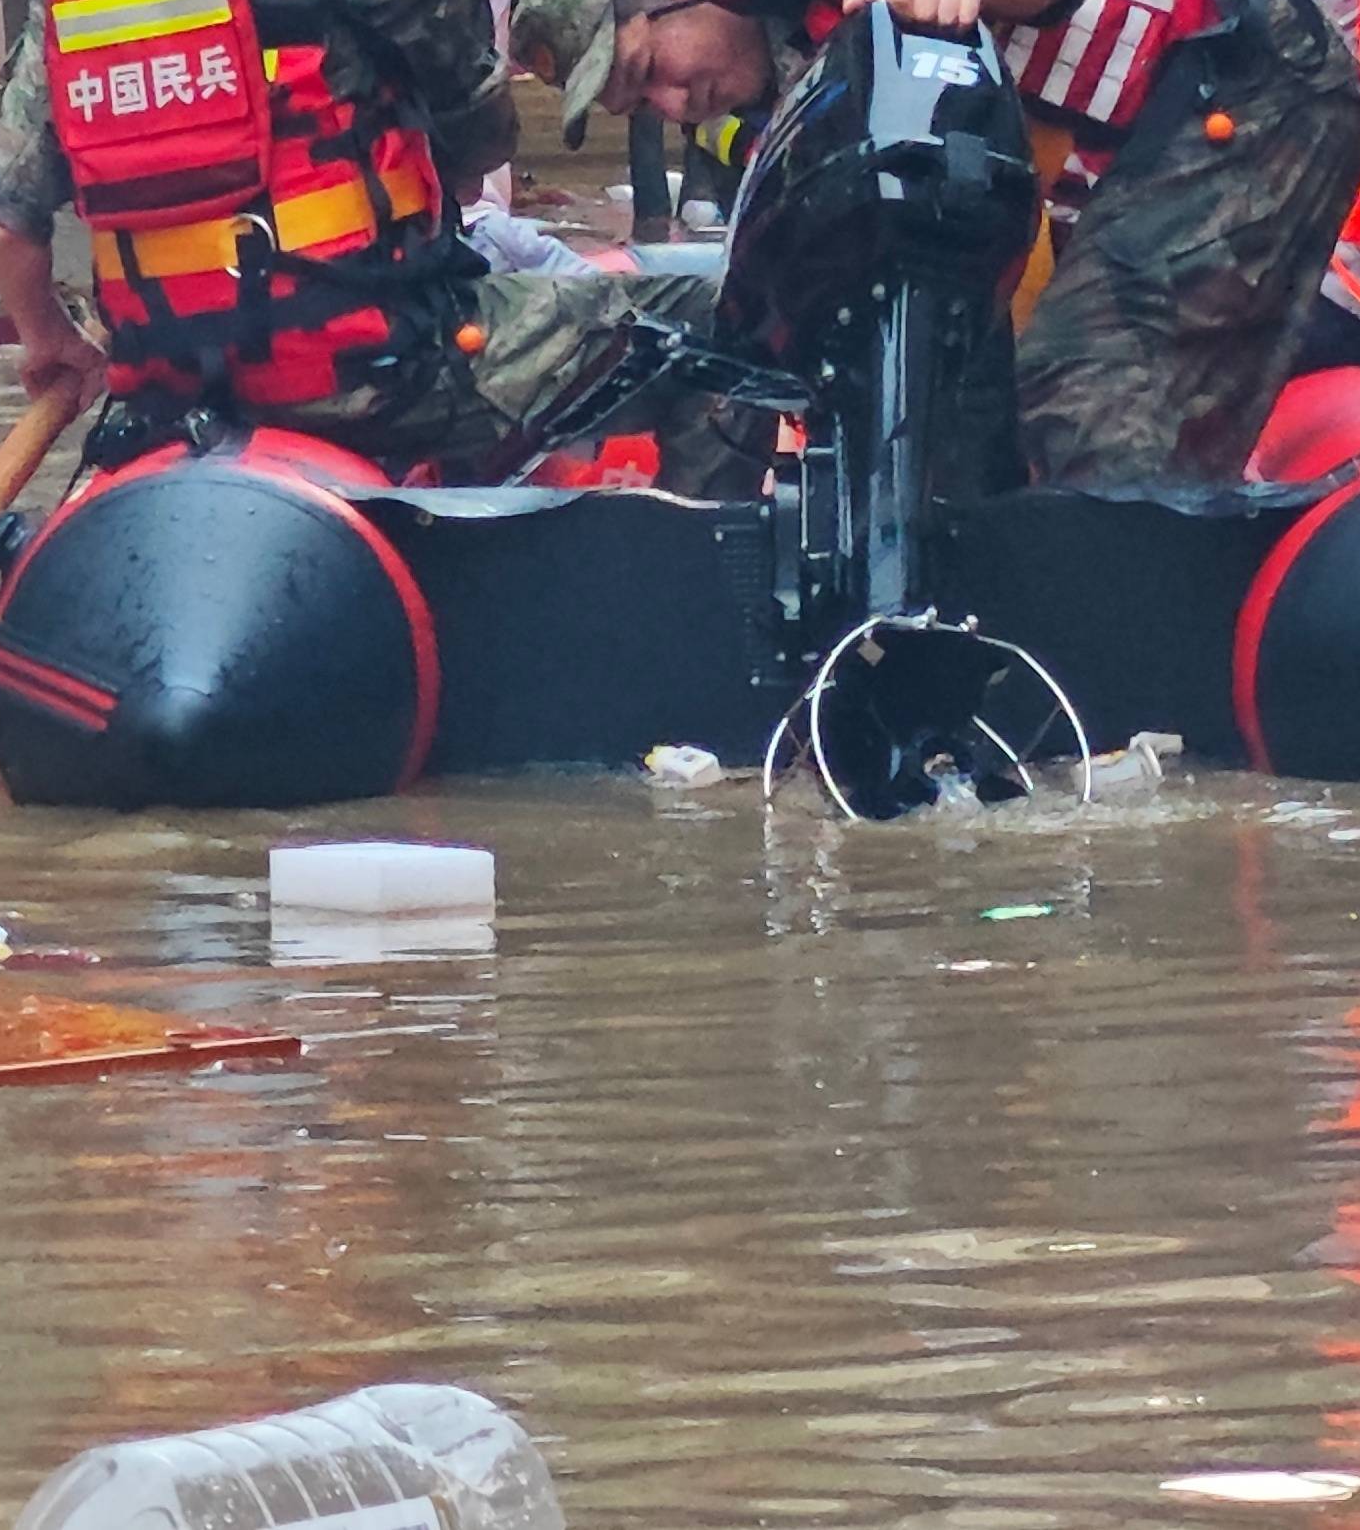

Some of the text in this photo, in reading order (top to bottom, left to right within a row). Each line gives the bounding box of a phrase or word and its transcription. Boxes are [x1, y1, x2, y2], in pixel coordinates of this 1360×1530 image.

[67, 45, 238, 123] 中国民兵
[911, 51, 980, 86] 15
